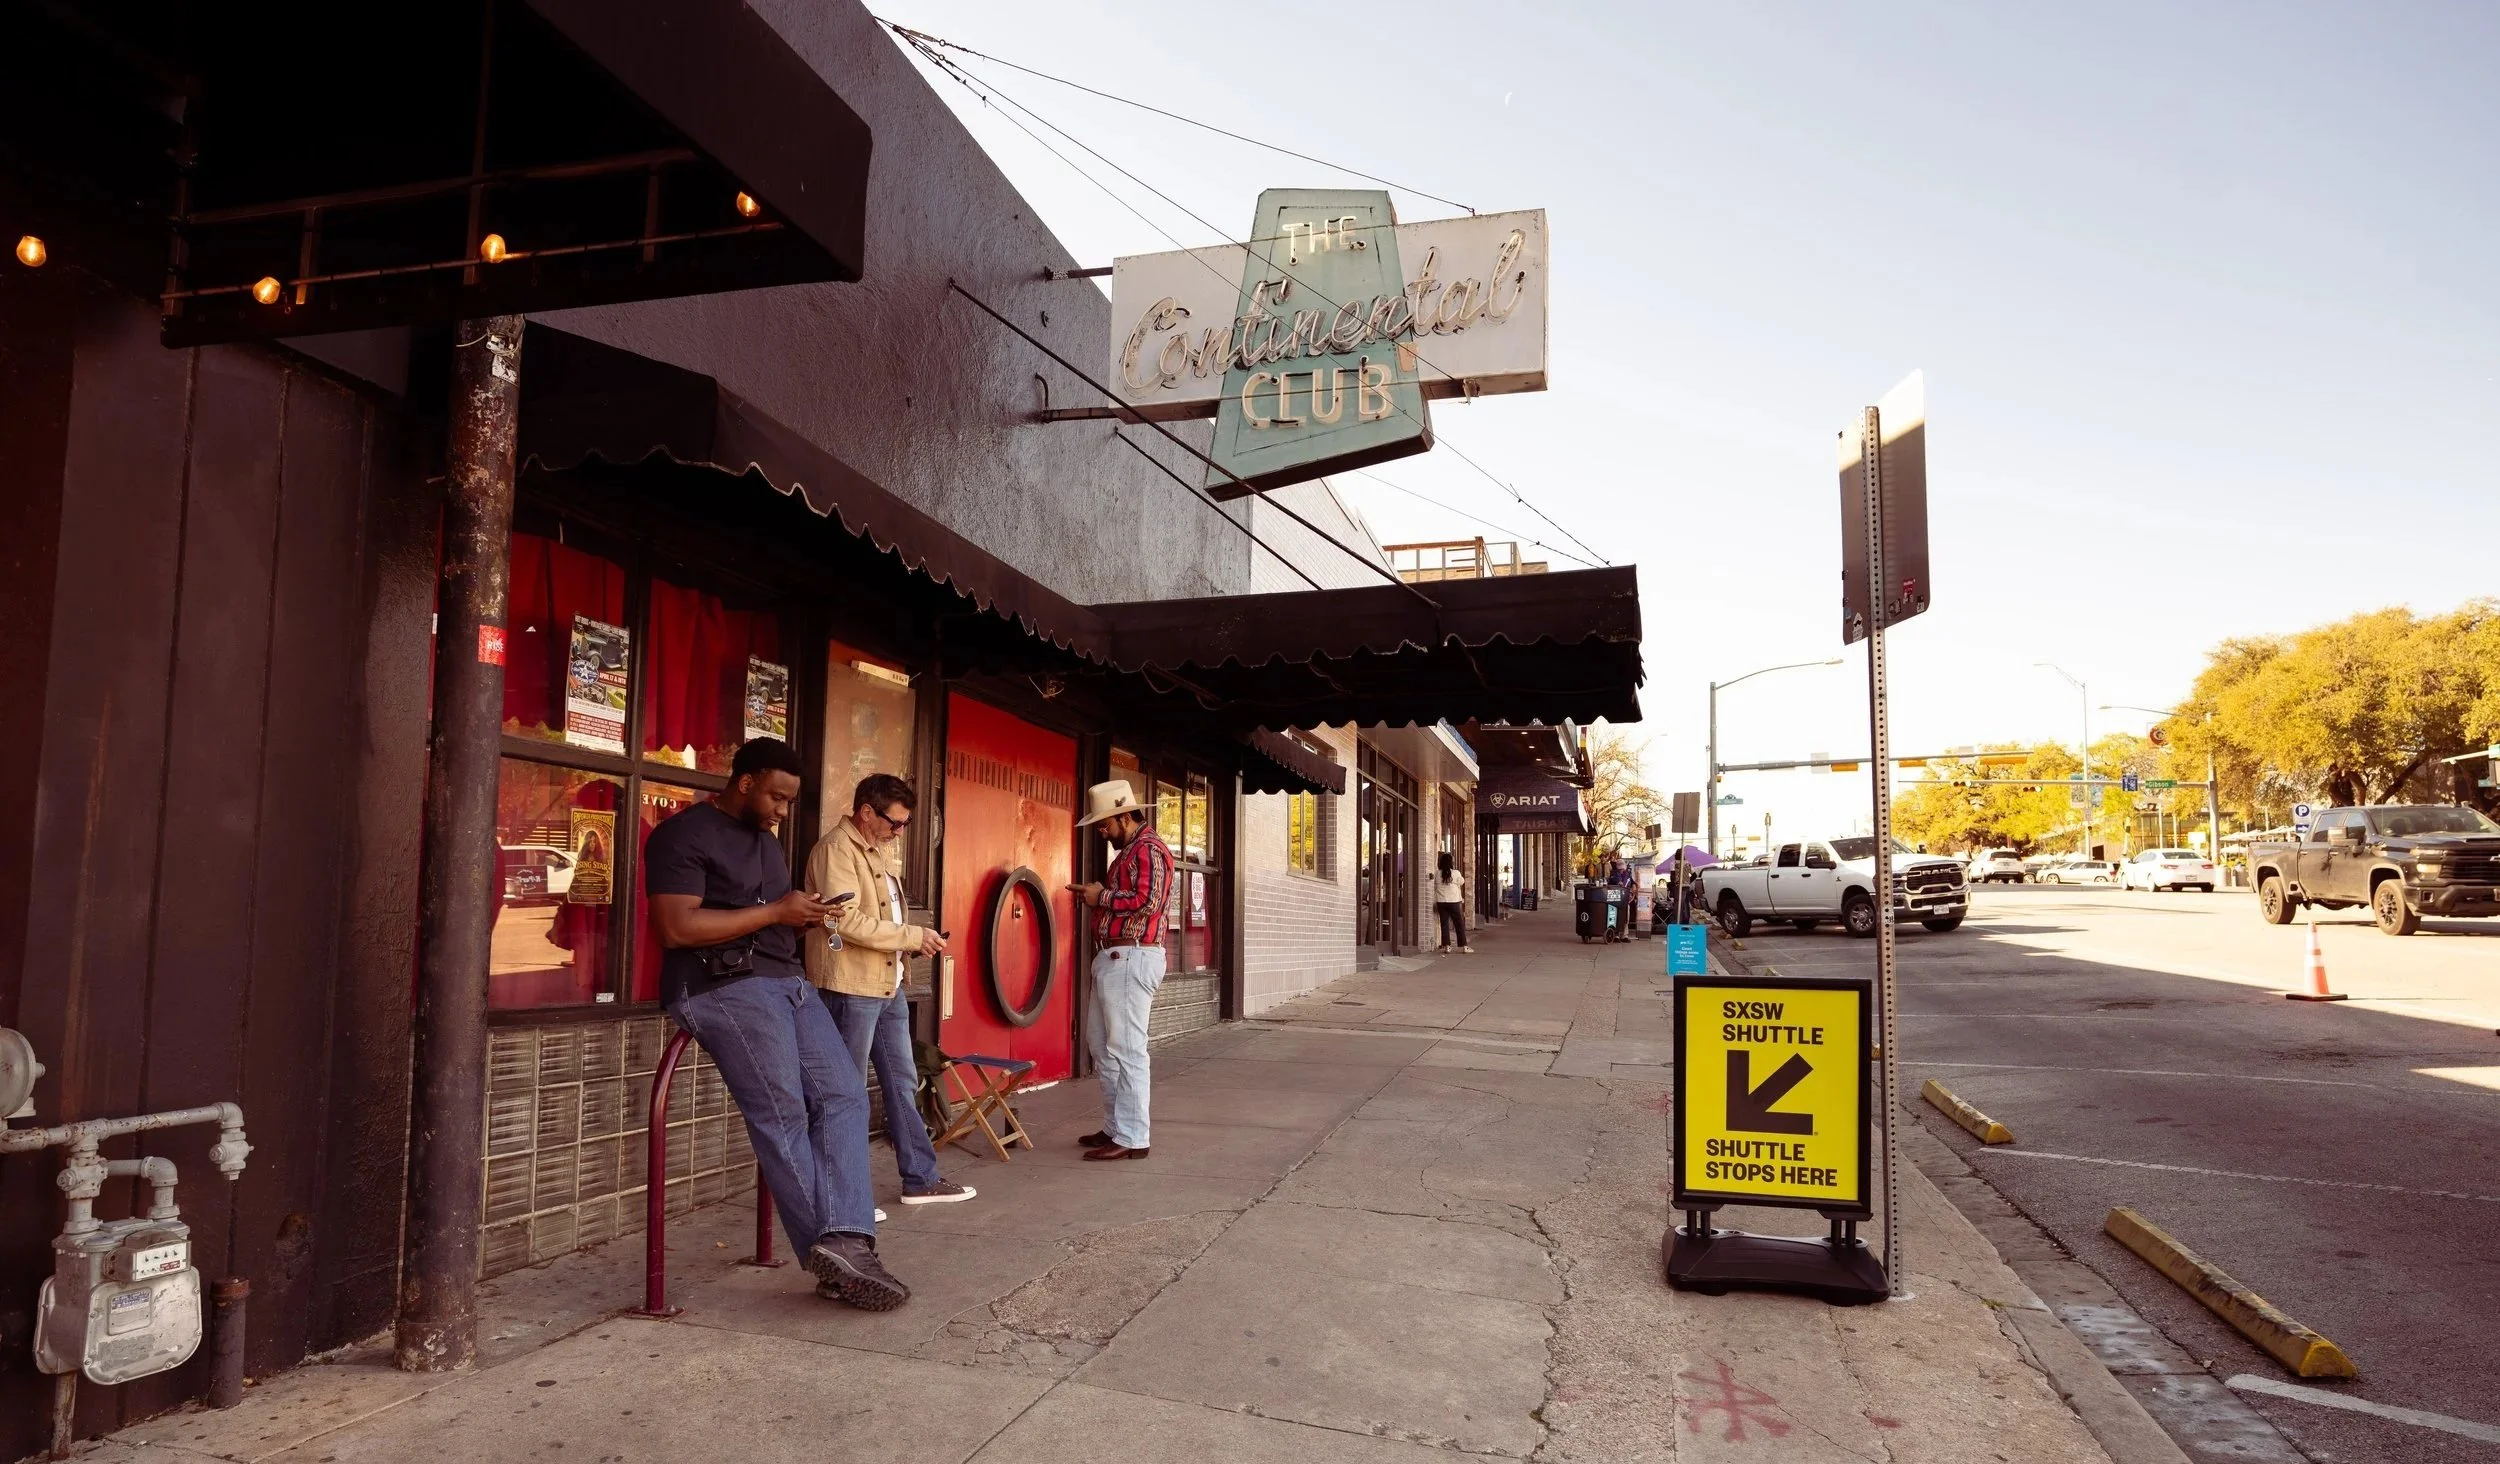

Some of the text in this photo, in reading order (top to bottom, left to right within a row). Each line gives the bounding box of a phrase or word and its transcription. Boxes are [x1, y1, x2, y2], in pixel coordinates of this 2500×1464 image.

[1282, 215, 1367, 265] THE
[1119, 228, 1527, 396] Continental
[1241, 362, 1394, 430] CLUB
[1506, 795, 1560, 806] ARIAT
[1722, 1001, 1784, 1020] SXSW
[1722, 1023, 1824, 1045] SHUTTLE
[1705, 1138, 1805, 1161] SHUTTLE
[1705, 1161, 1838, 1186] STOPS HERE
